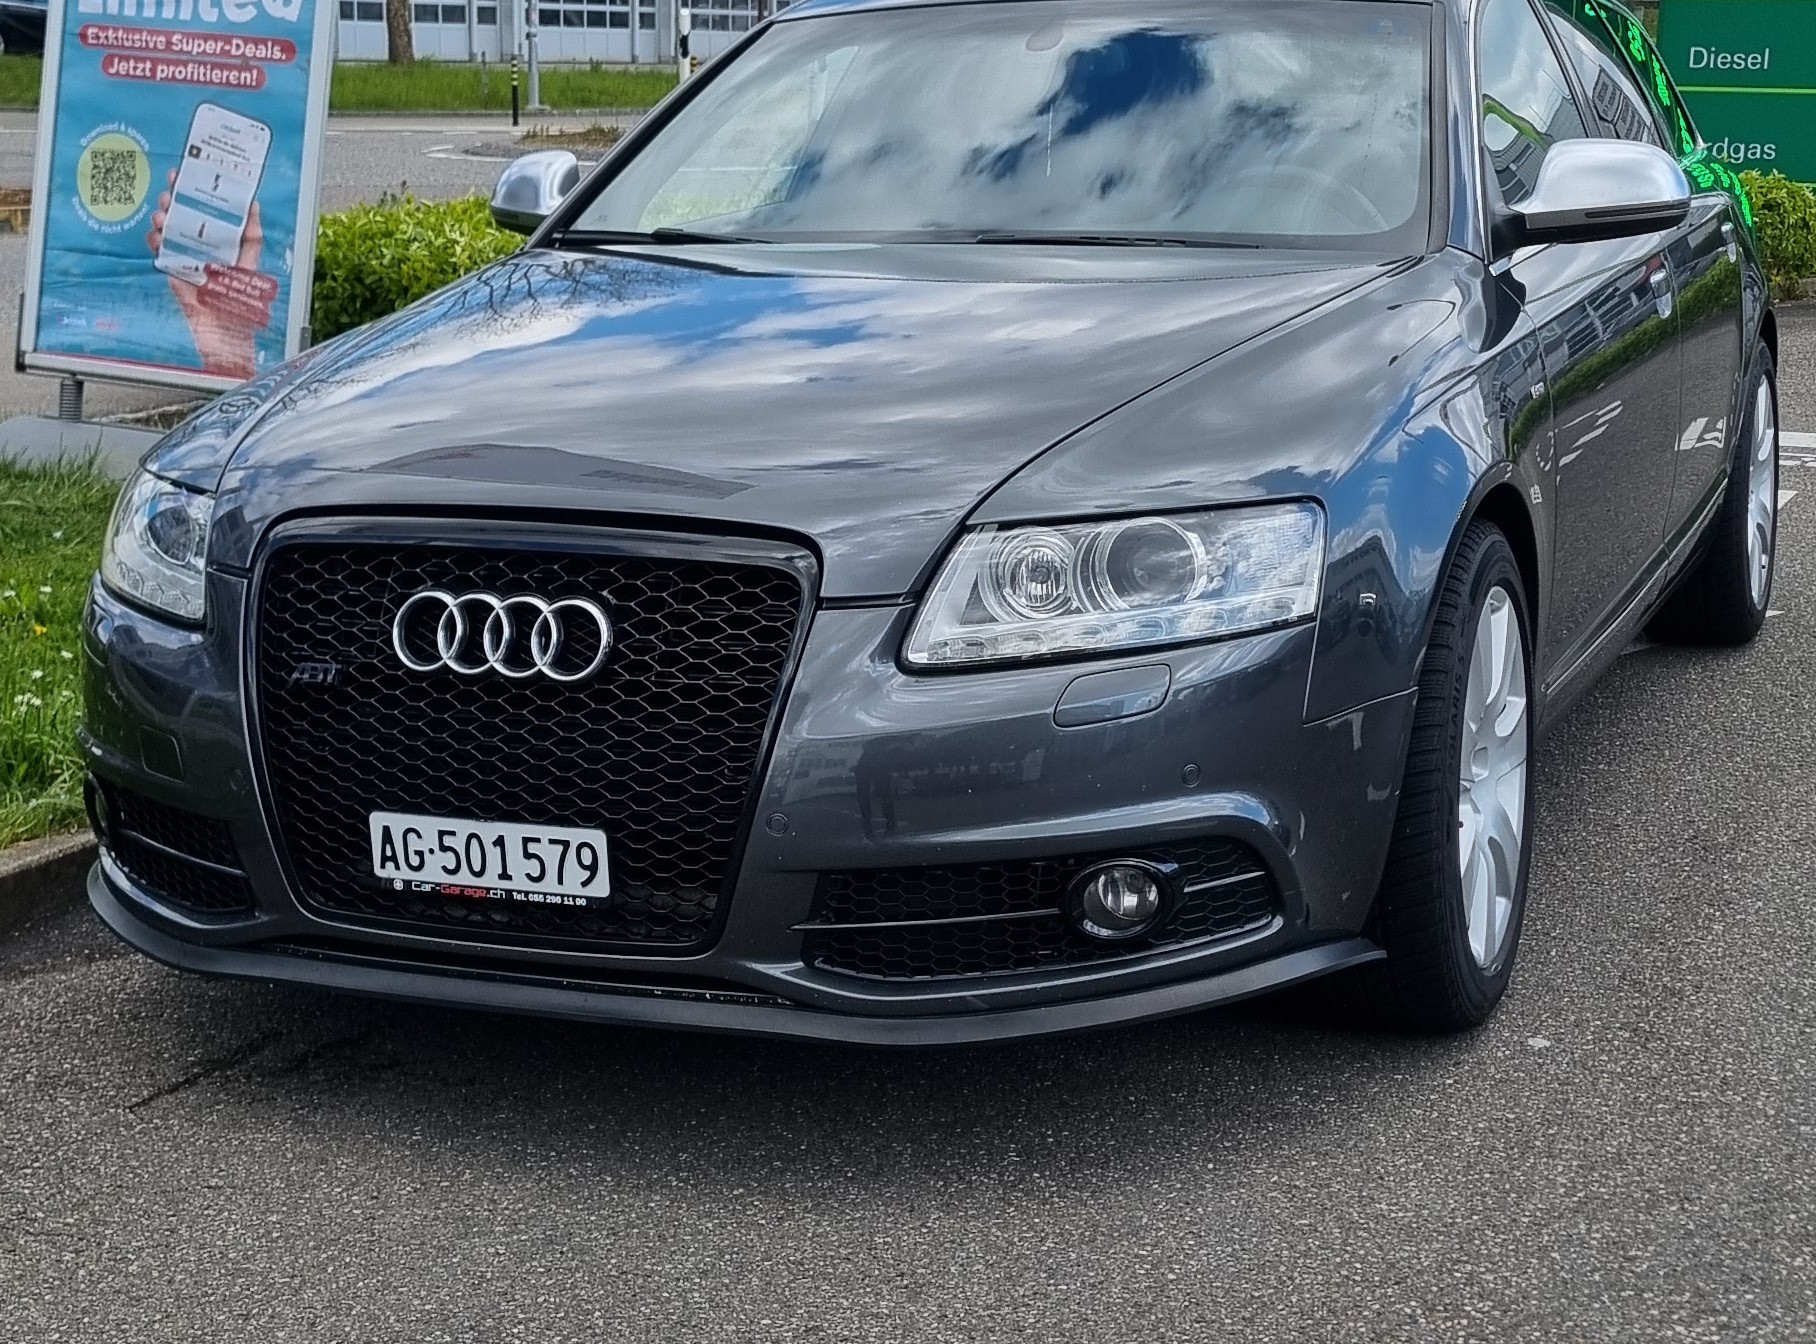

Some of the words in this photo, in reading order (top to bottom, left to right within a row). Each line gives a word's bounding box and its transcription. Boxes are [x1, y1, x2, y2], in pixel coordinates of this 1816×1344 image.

[86, 27, 167, 50] Exklusive
[172, 33, 287, 60] Super-Deals.
[1689, 46, 1770, 70] Diesel
[108, 57, 151, 77] Jetzt
[156, 63, 258, 86] profitieren!
[411, 881, 506, 899] Car-Garage.ch
